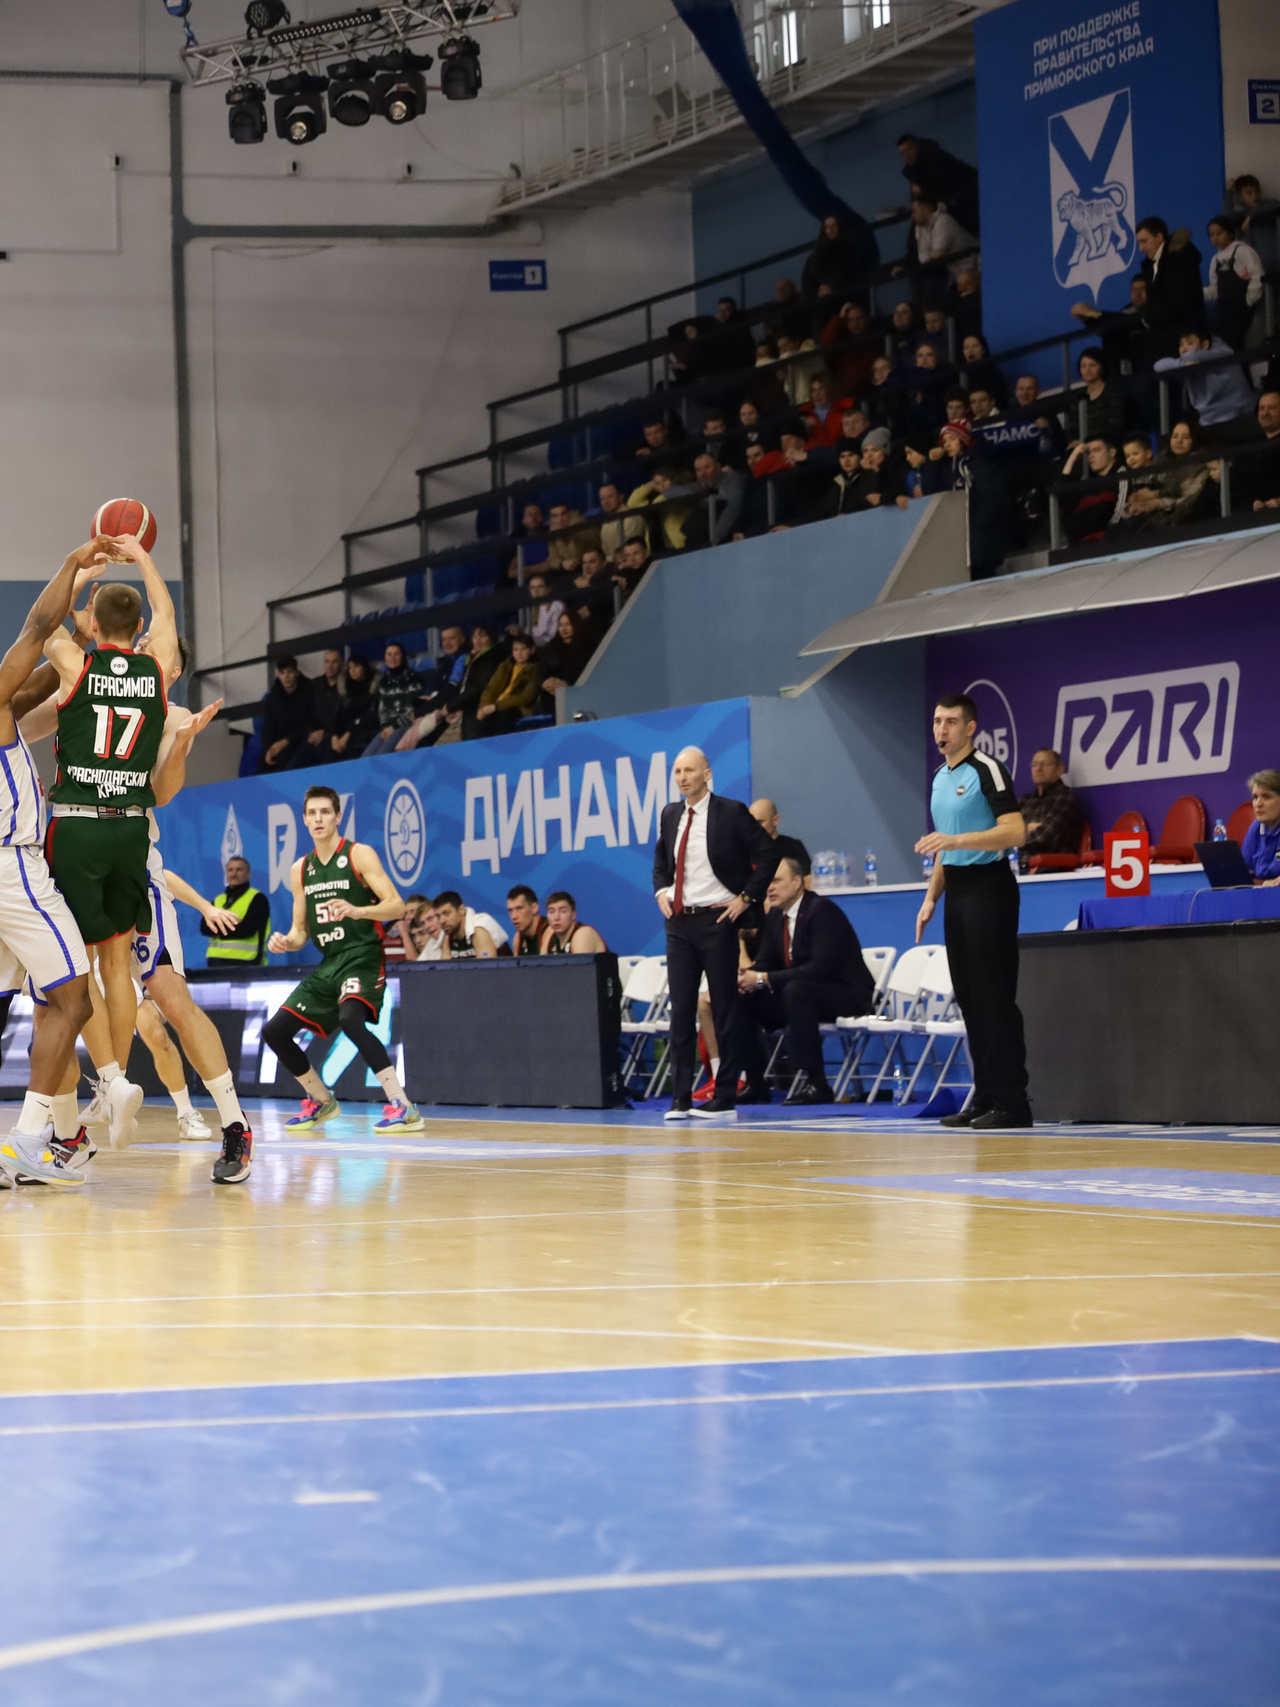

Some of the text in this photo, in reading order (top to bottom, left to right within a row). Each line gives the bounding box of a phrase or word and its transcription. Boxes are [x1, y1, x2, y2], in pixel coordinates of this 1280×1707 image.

[1033, 1, 1140, 58] ПРИ ПОДДЕРЖКЕ
[1033, 21, 1141, 78] ПРАВИТЕЛЬСТВА
[1024, 36, 1154, 101] ПРИМОРСКОГО КРАЯ
[1261, 98, 1275, 114] 2
[88, 673, 156, 698] ГЕРАСИМОВ
[91, 704, 146, 760] 17
[973, 727, 1009, 763] ФБ
[1060, 676, 1230, 774] PARI
[304, 879, 350, 896] ЛОКОМОТИВ
[1109, 839, 1145, 890] 5
